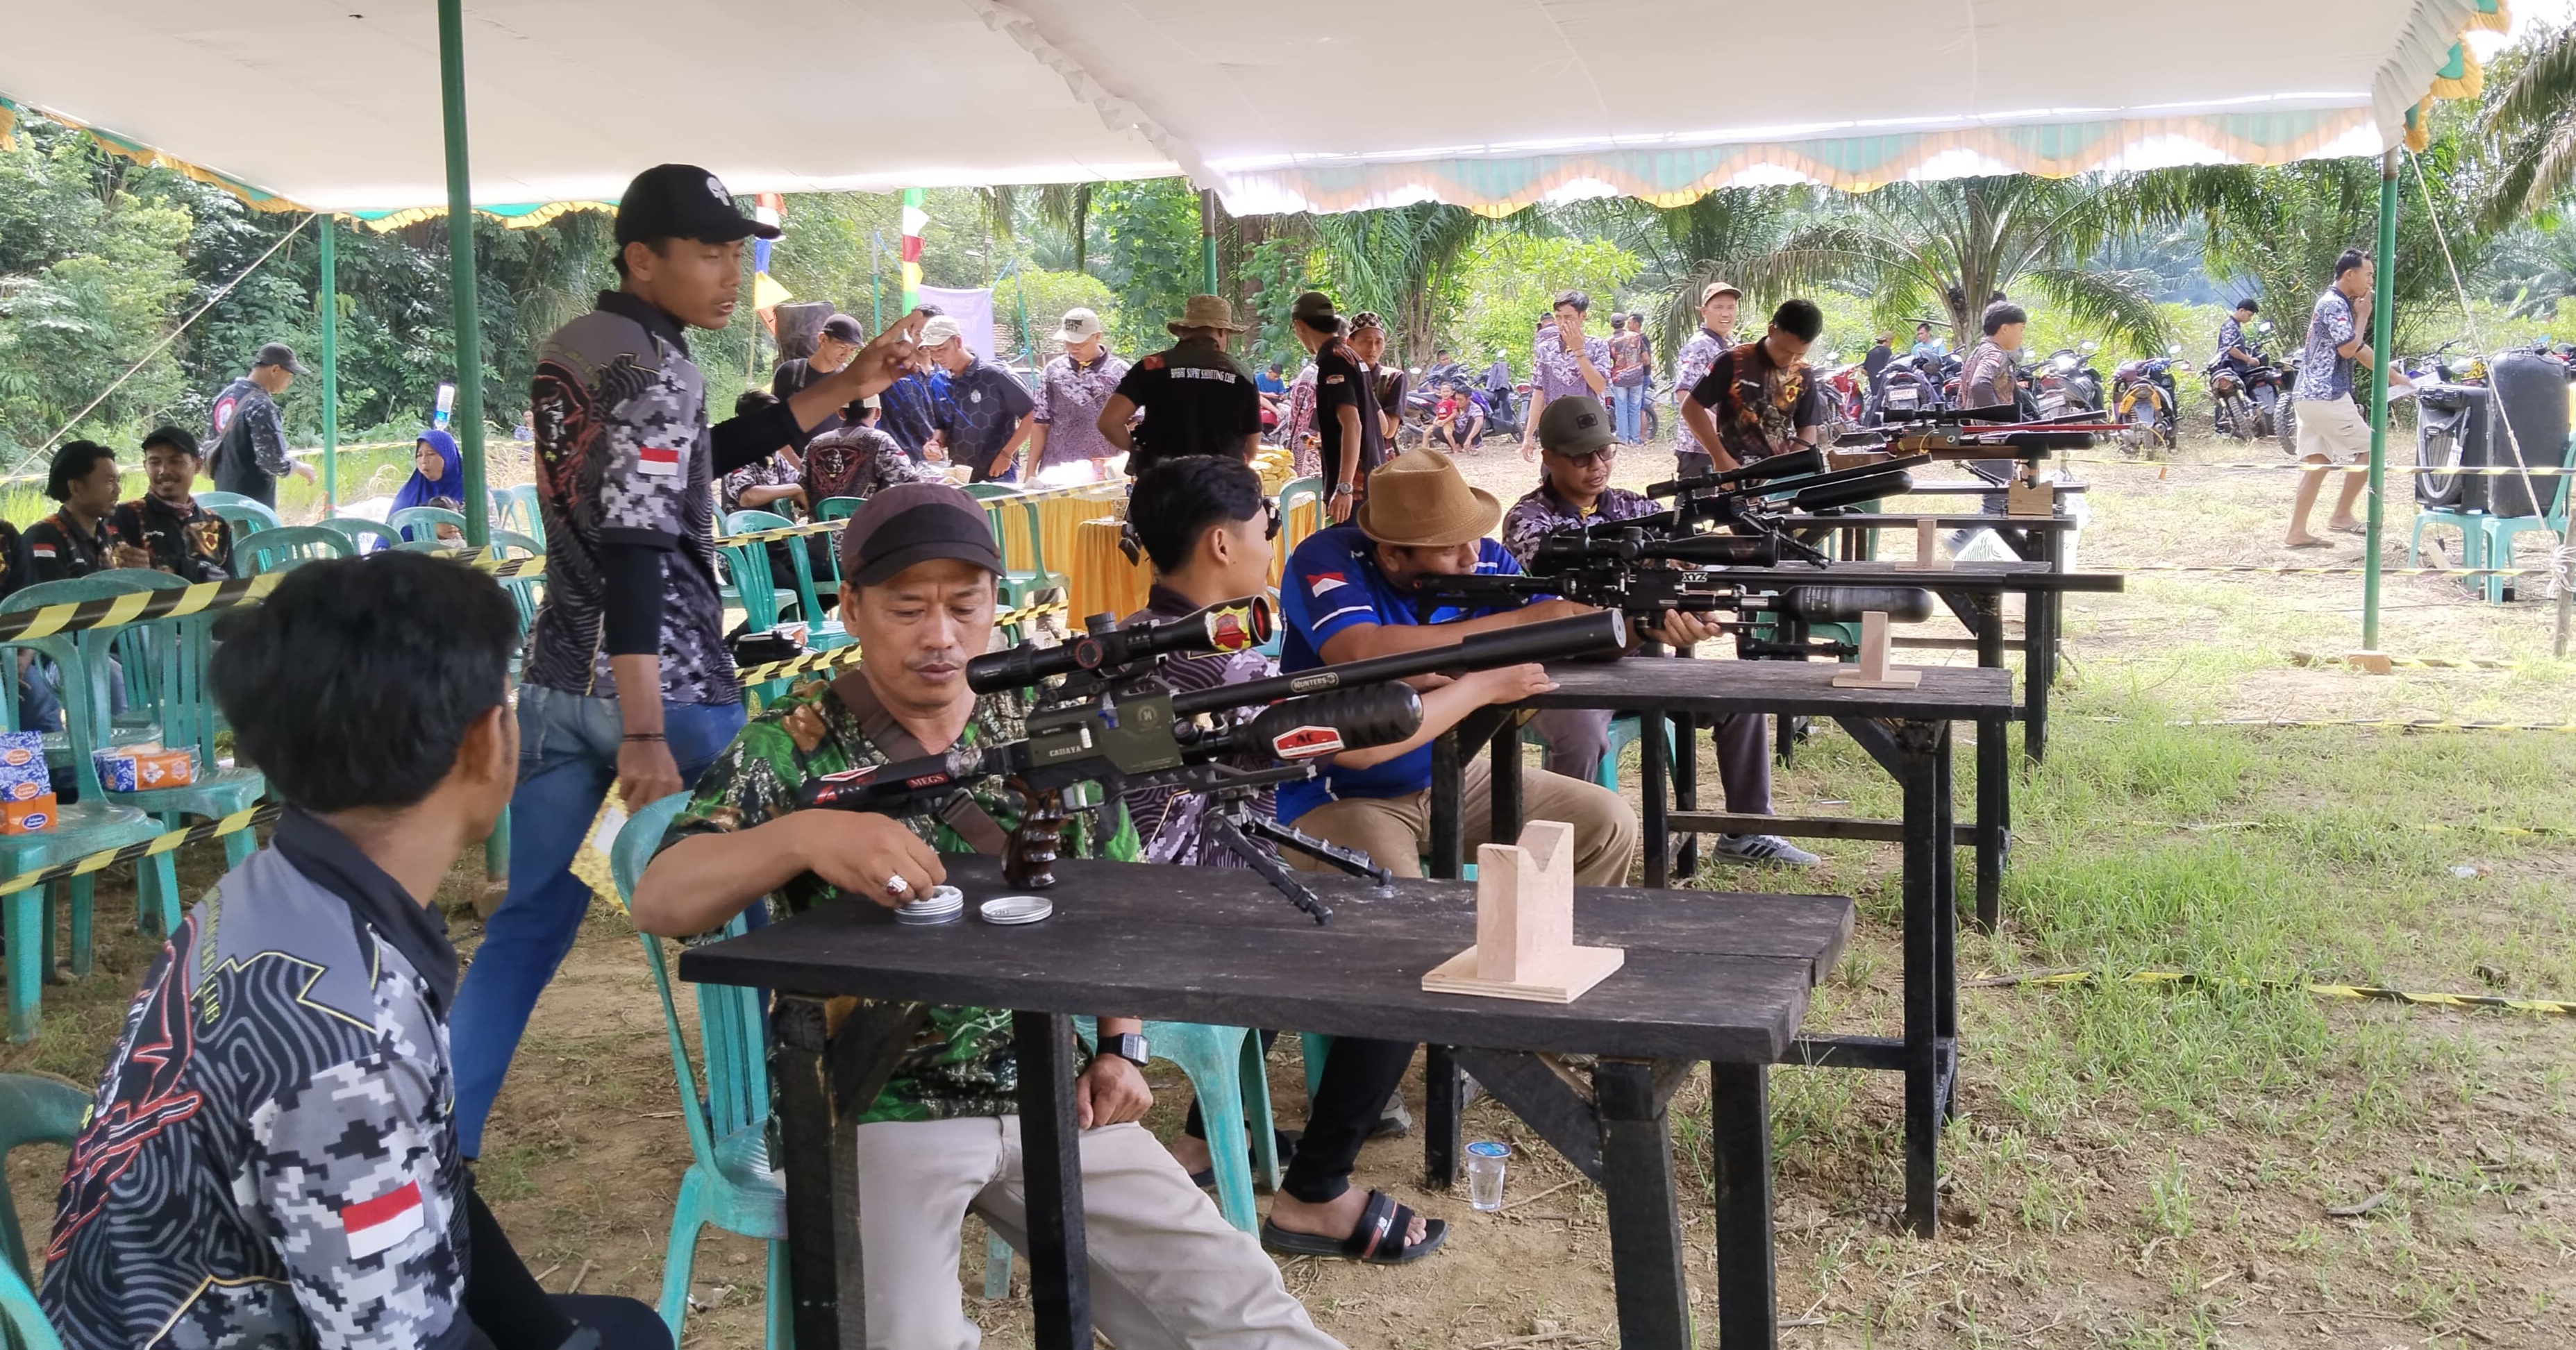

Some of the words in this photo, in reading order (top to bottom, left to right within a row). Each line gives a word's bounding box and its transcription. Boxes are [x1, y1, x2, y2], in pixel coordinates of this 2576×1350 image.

[1682, 573, 1707, 582] XYZ
[1294, 677, 1327, 689] HUNTERS
[911, 774, 945, 788] MEGS
